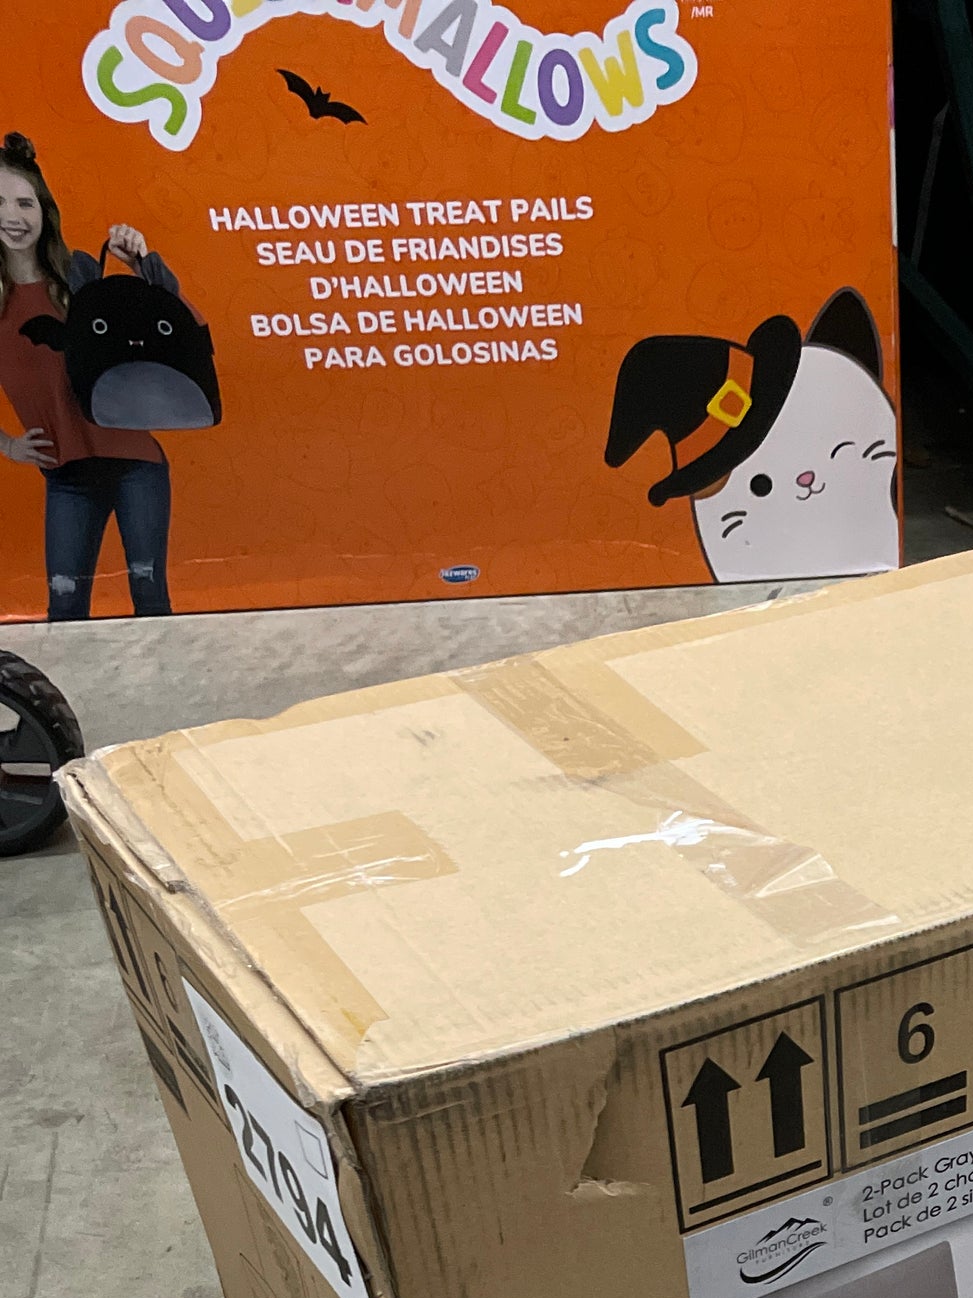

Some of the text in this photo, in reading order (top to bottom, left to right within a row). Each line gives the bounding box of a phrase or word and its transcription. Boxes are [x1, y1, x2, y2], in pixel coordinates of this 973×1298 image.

[97, 0, 685, 136] SQUALLOWS
[209, 196, 593, 231] HALLOWEEN TREAT PAILS
[257, 233, 564, 265] SEAU DE FRIANDISES
[310, 270, 523, 300] D'HALLOWEEN
[250, 303, 582, 337] BOLSA DE HALLOWEEN
[304, 339, 558, 369] PARA GOLOSINAS
[897, 1001, 937, 1064] 6
[224, 1083, 353, 1287] 2794
[863, 1166, 928, 1202] 2-Pack
[864, 1200, 892, 1222] Lot
[897, 1192, 922, 1209] de
[928, 1183, 938, 1198] 2
[864, 1215, 911, 1243] Pack
[917, 1206, 941, 1222] de
[947, 1196, 957, 1211] 2
[737, 1222, 827, 1264] GilmanCreek
